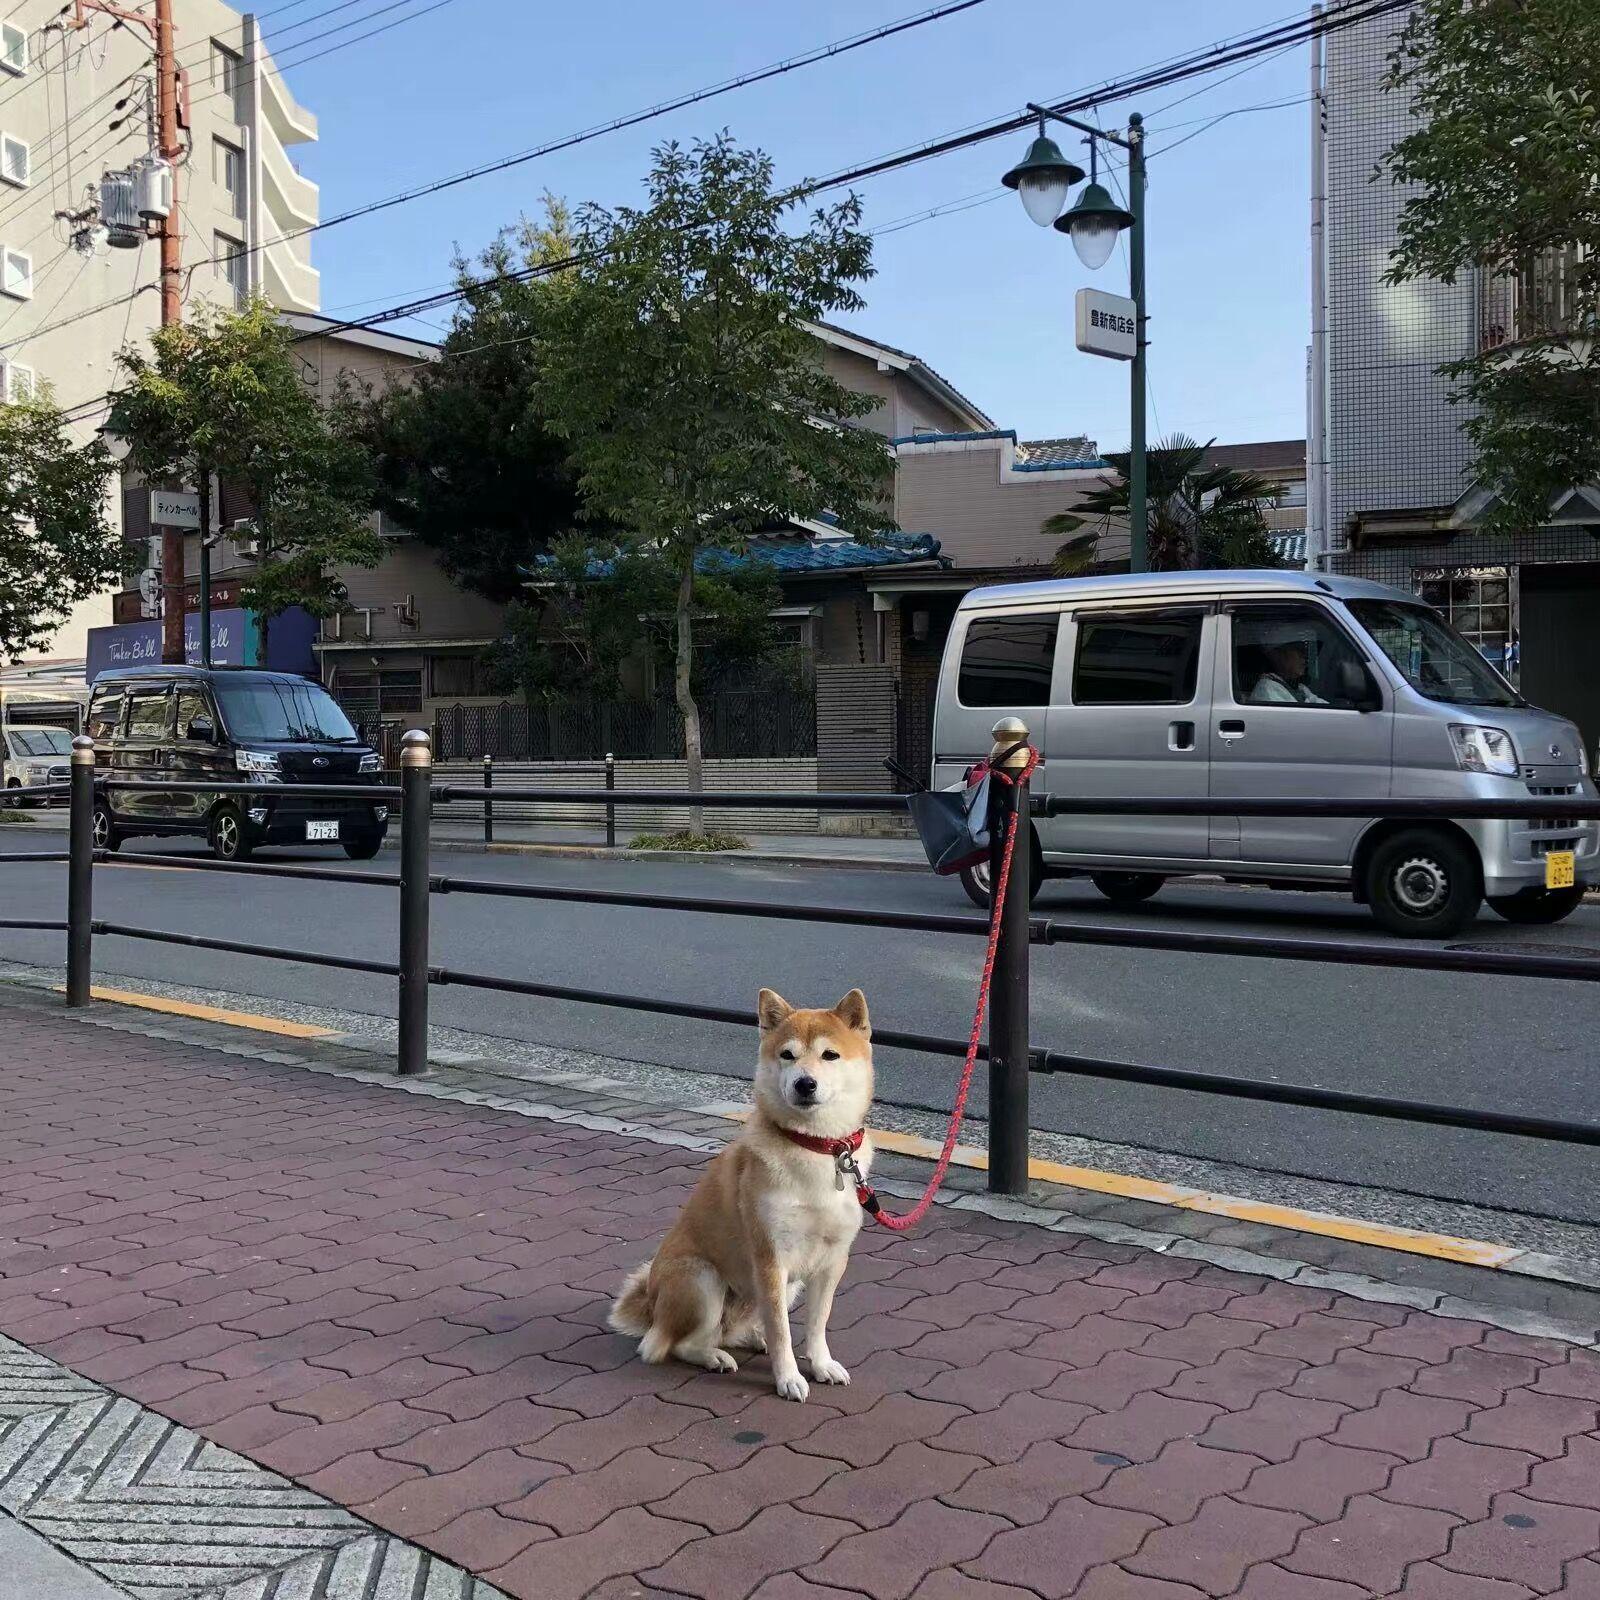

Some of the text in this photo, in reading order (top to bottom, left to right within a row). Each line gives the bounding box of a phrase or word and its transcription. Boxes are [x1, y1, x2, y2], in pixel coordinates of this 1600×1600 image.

[1091, 309, 1135, 335] 豊新商店会
[158, 503, 198, 516] ティンカーベル
[132, 638, 156, 660] Bell
[313, 829, 338, 838] 71-23
